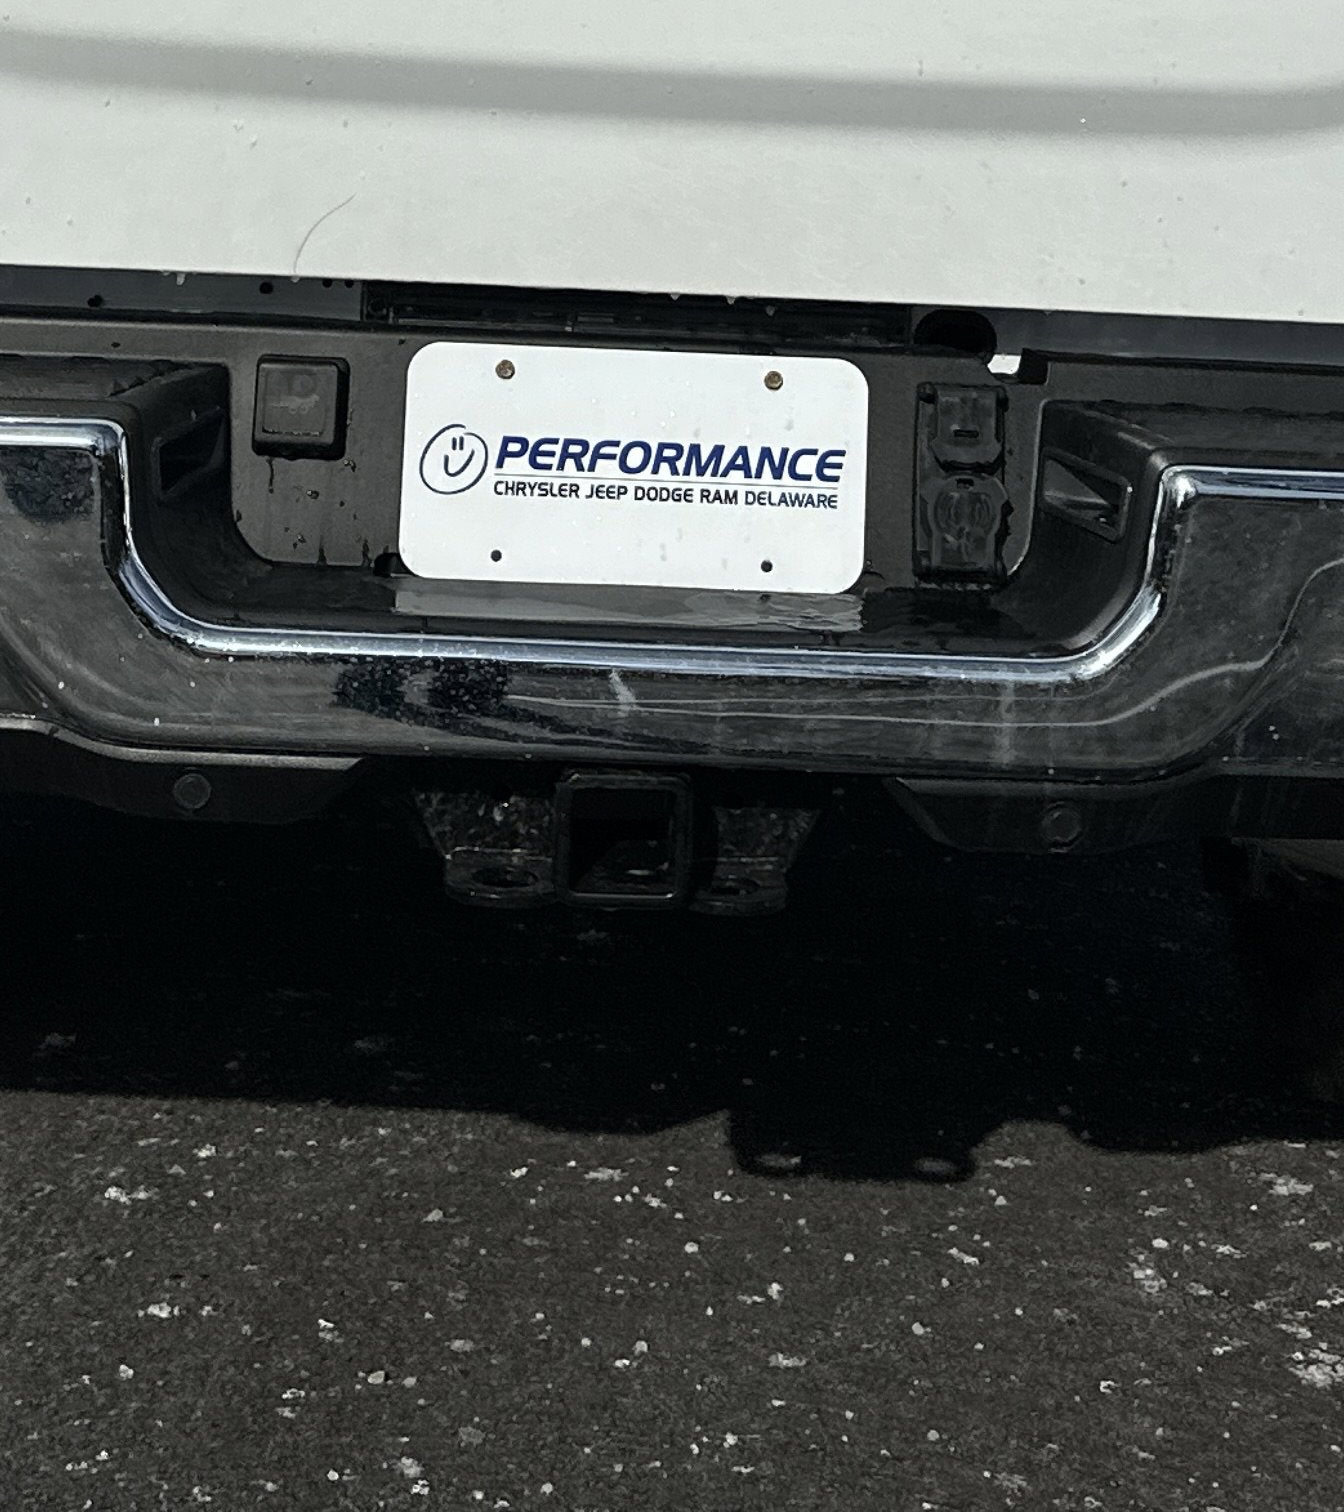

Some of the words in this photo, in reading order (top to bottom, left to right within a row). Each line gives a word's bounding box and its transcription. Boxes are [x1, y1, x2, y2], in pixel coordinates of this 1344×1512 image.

[495, 435, 847, 483] PERFORMANCE
[493, 480, 580, 499] CHRYSLER
[585, 483, 628, 501] JEEP
[634, 485, 694, 504] DODGE
[700, 488, 739, 506] RAM
[744, 490, 839, 509] DELAWARE
